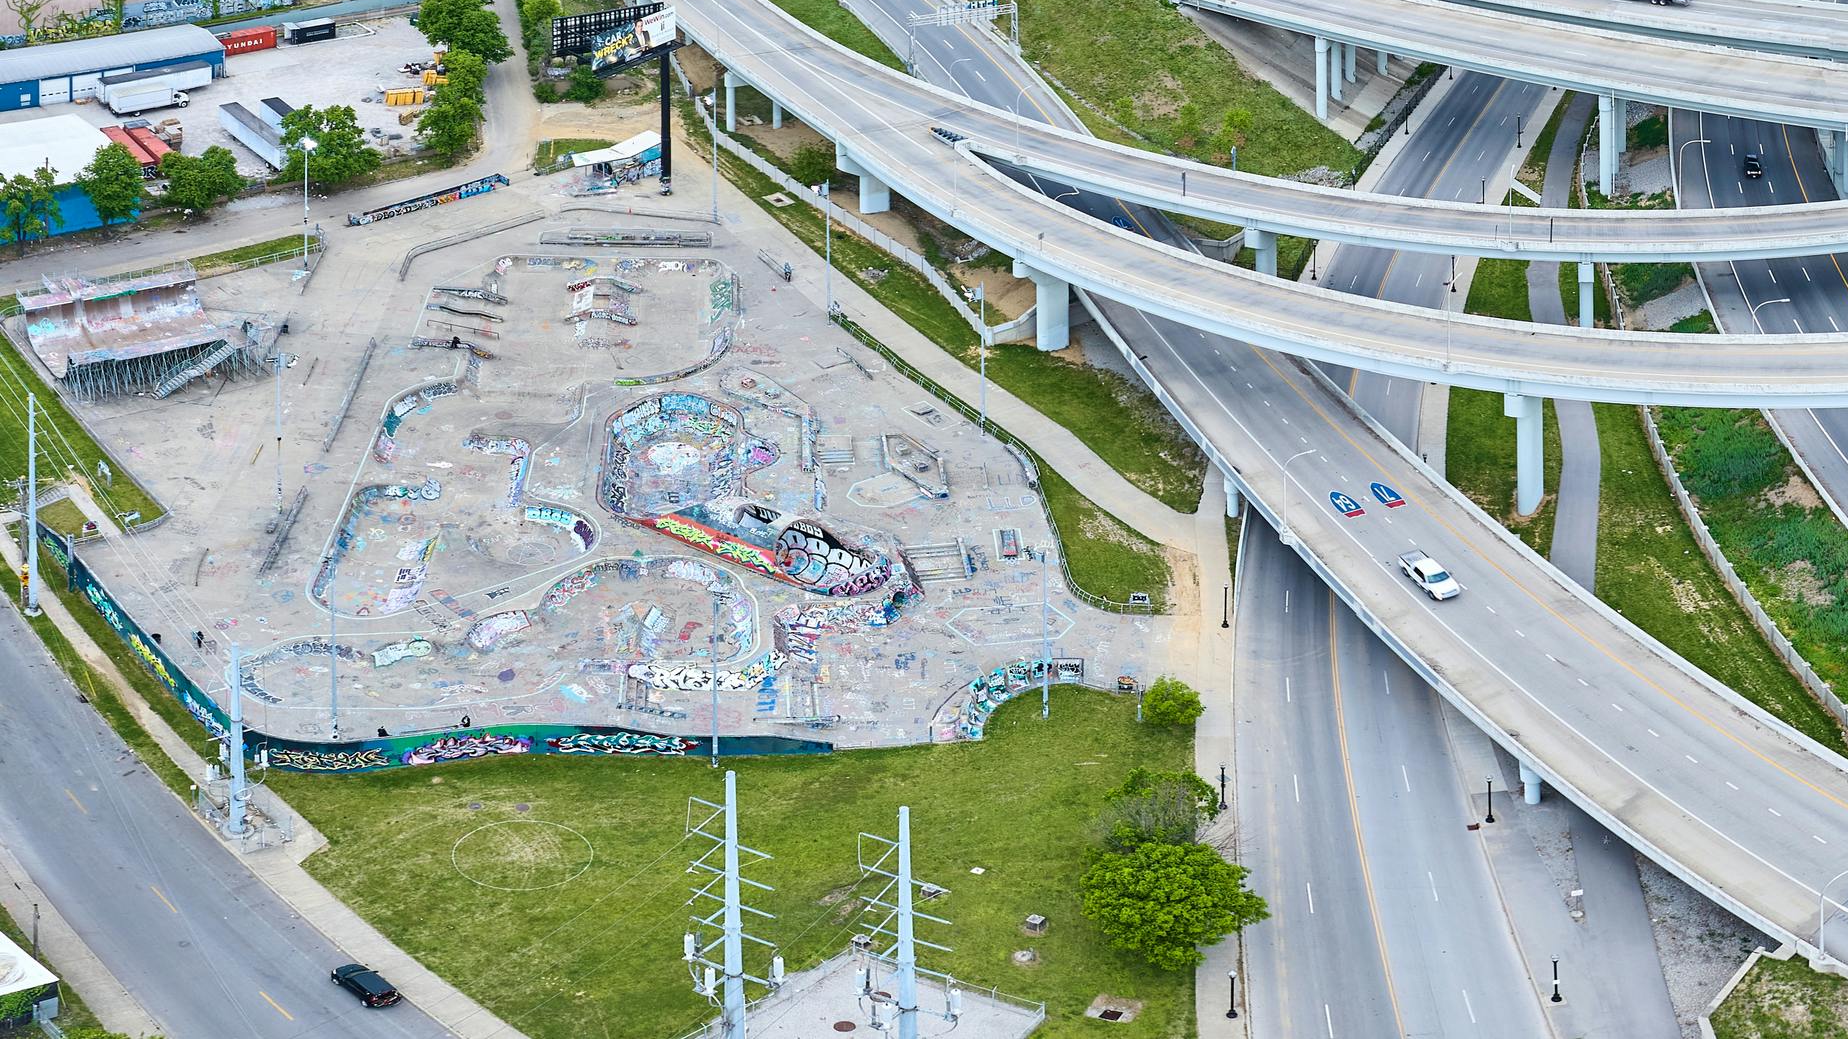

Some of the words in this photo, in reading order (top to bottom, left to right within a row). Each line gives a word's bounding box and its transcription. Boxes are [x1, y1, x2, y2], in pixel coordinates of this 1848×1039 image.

[225, 38, 263, 50] YUNDAI
[594, 33, 634, 59] WRECK?
[605, 32, 622, 46] CAR
